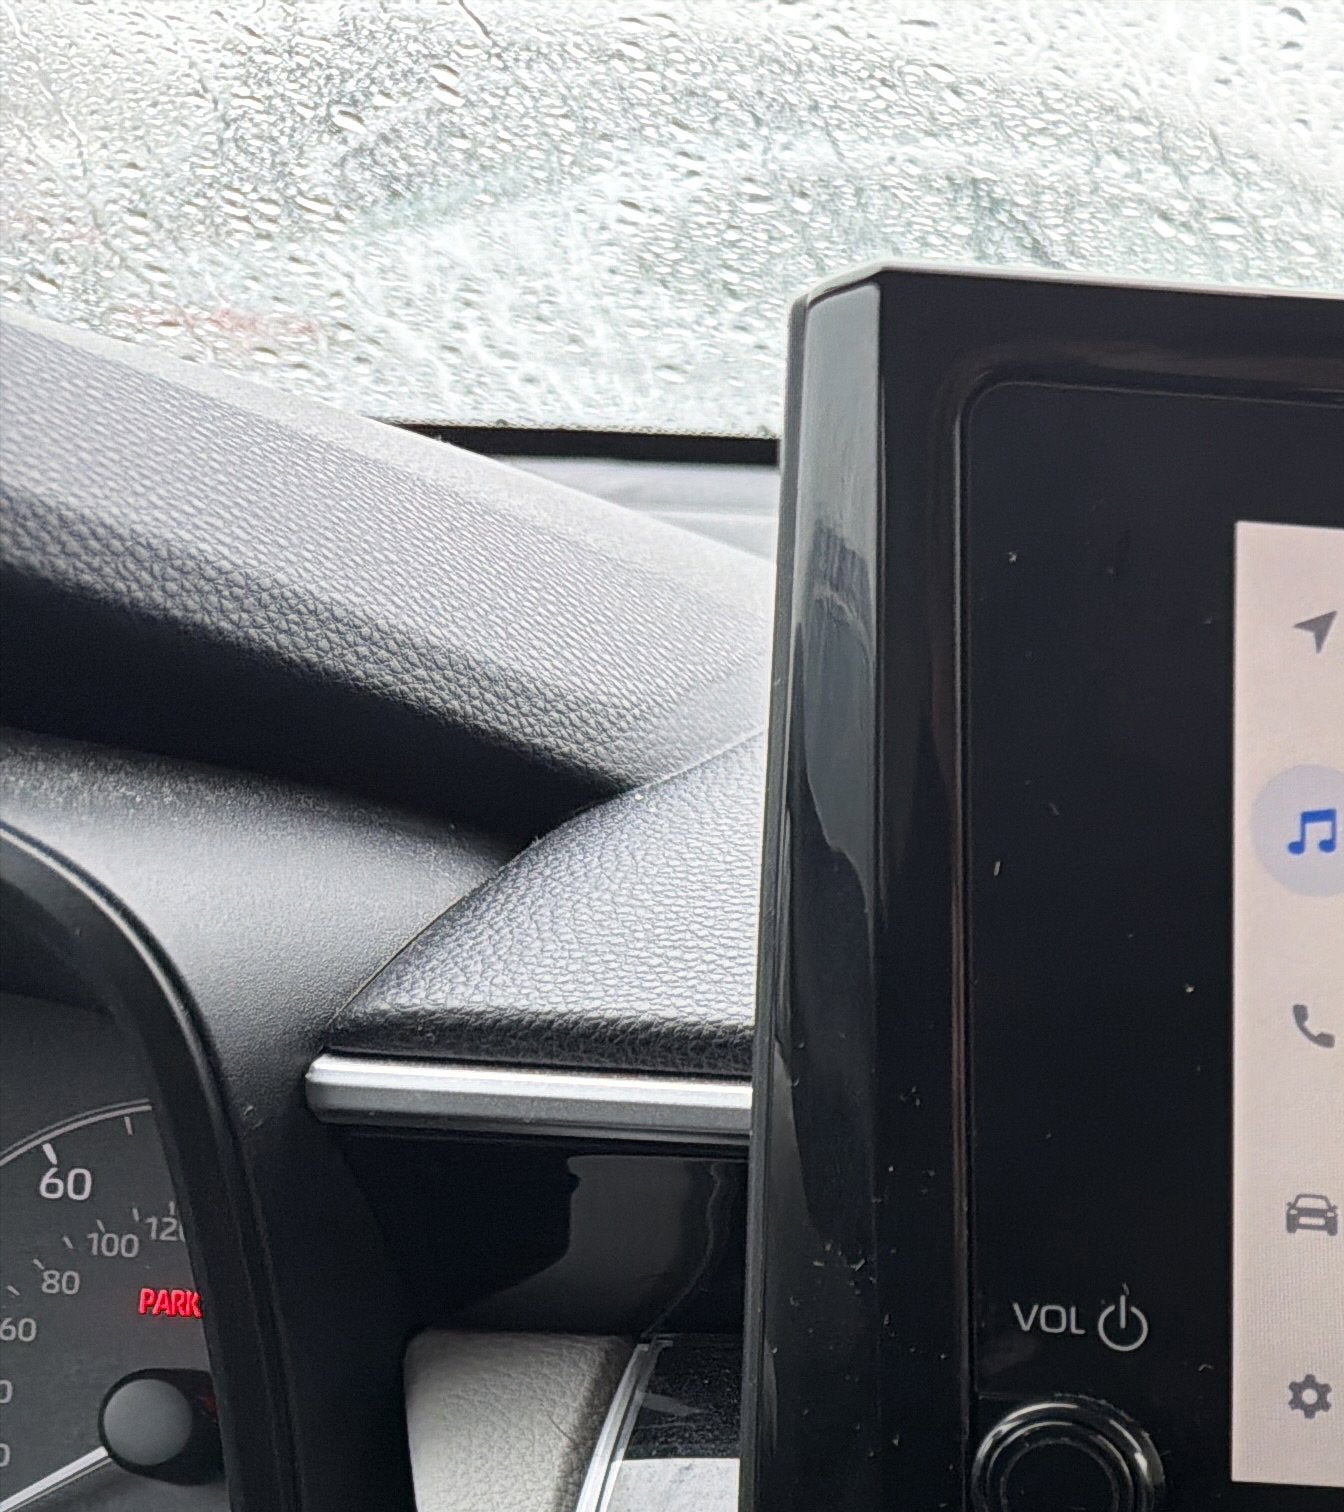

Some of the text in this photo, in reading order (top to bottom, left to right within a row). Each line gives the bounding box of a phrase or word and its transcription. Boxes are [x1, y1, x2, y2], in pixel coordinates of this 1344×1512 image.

[39, 1167, 92, 1201] 60
[87, 1232, 139, 1258] 100
[41, 1270, 81, 1295] 80
[138, 1287, 204, 1318] PARK
[0, 1317, 37, 1342] 60
[1012, 1302, 1086, 1335] VOL
